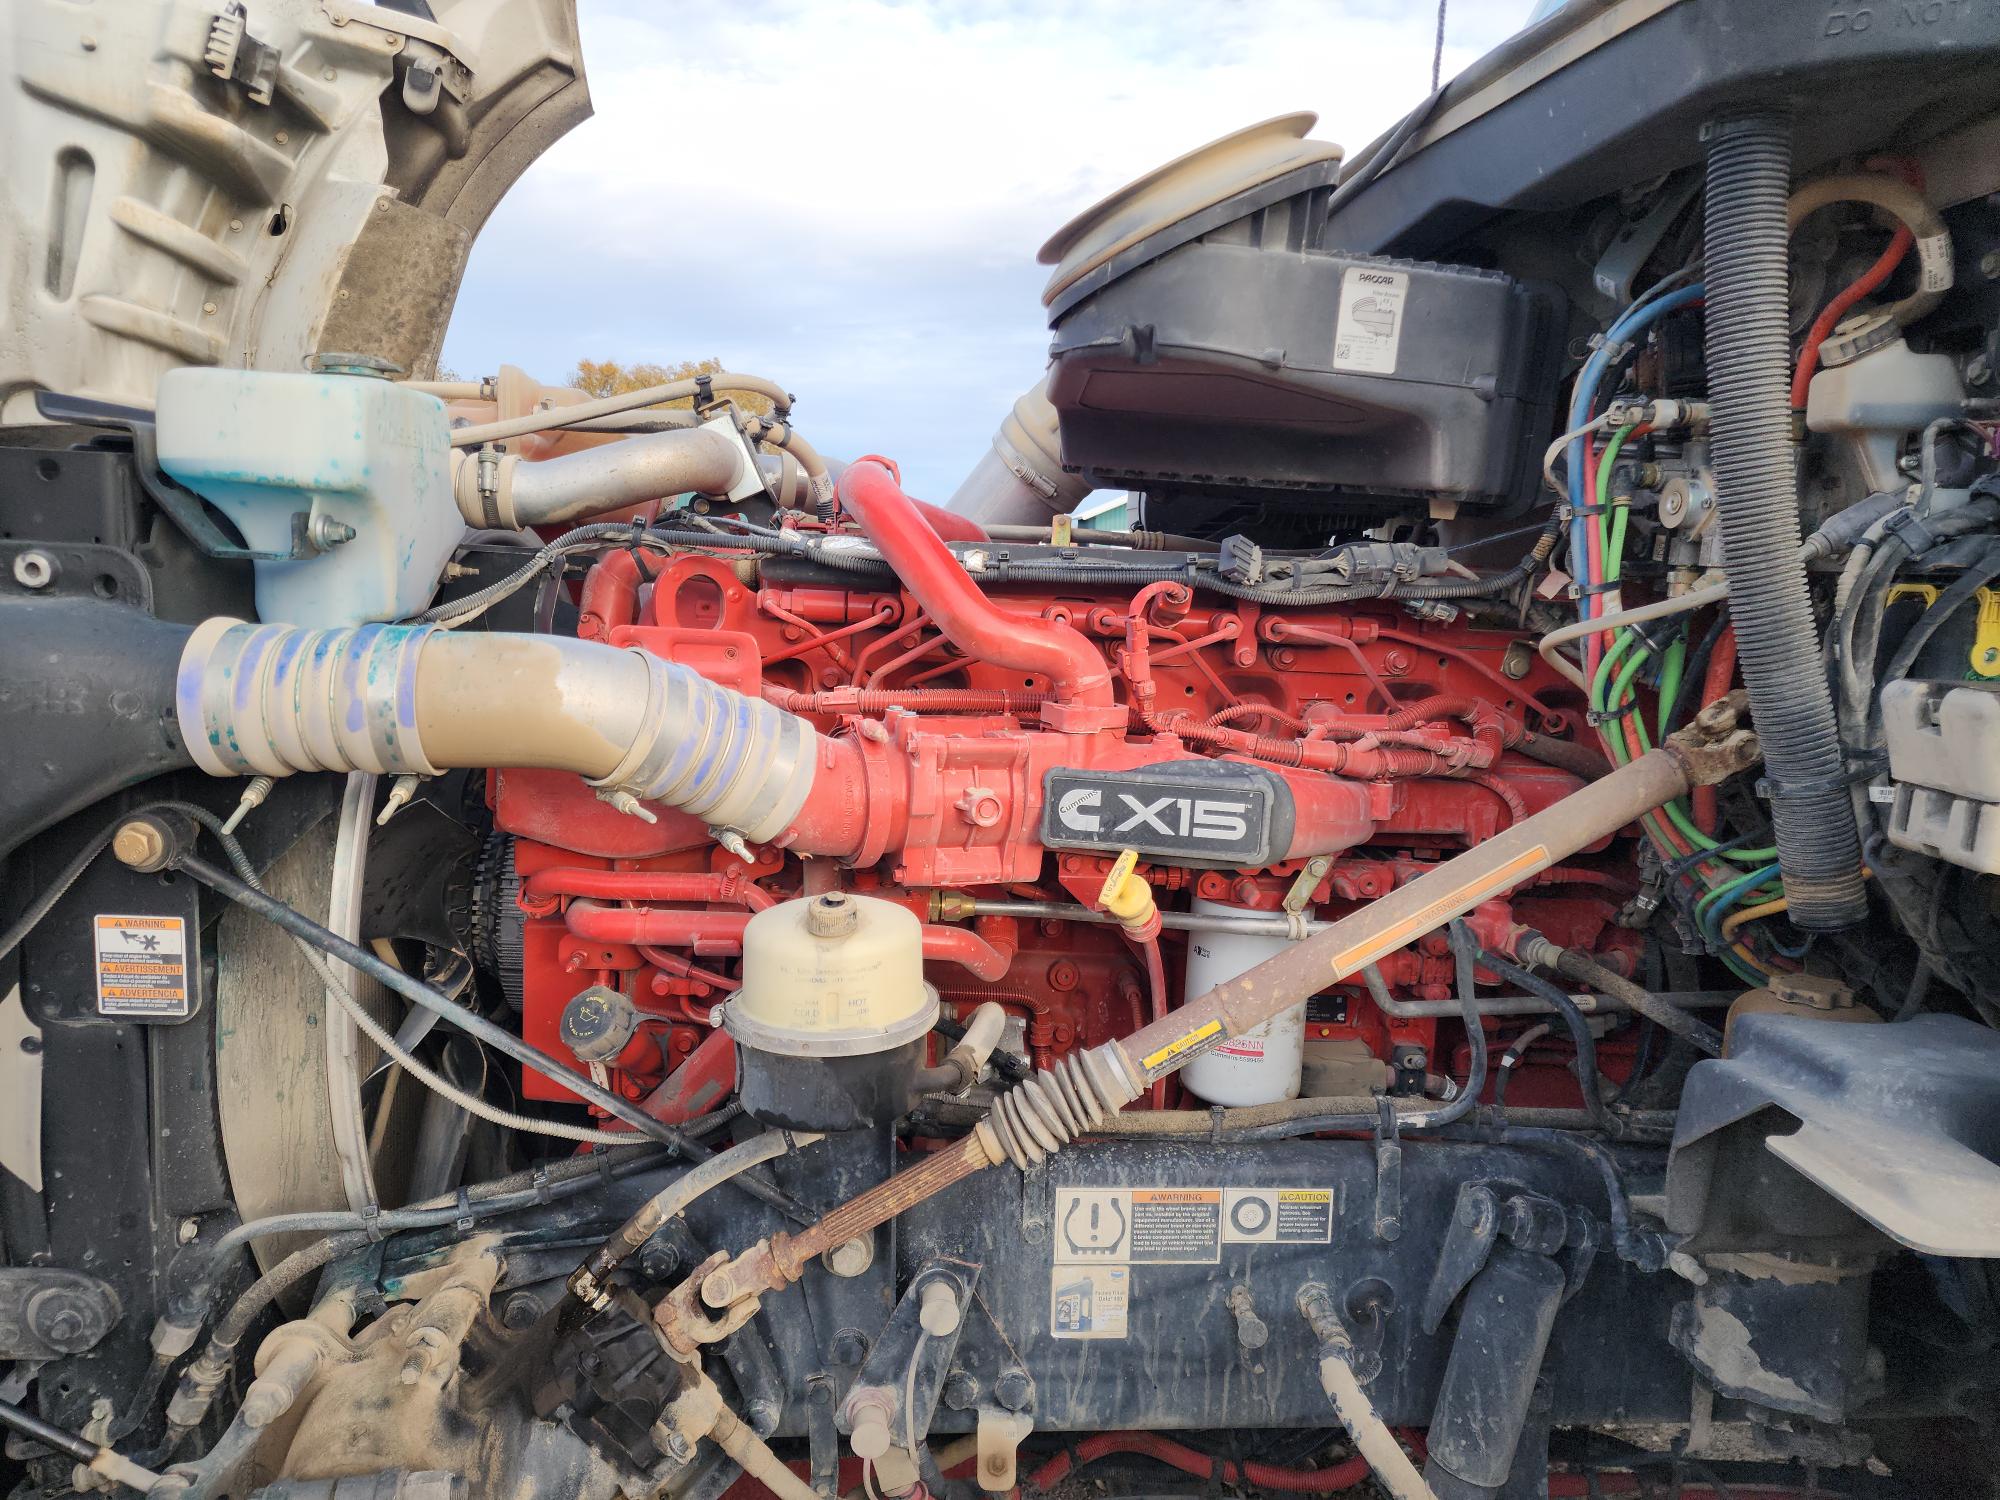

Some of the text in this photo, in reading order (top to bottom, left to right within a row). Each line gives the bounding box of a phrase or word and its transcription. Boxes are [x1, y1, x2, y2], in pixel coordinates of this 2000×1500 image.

[1358, 273, 1395, 285] PACCAR
[1059, 789, 1099, 814] Cummins
[1113, 793, 1247, 841] X15
[1420, 893, 1467, 922] WARNING
[125, 920, 166, 928] WARNING
[114, 964, 180, 974] AVERTISSEMENT
[120, 989, 178, 998] ADVERTENCIA
[1210, 1050, 1238, 1061] Cummins
[1158, 1193, 1202, 1201] WARNING
[1288, 1193, 1329, 1201] CAUTION
